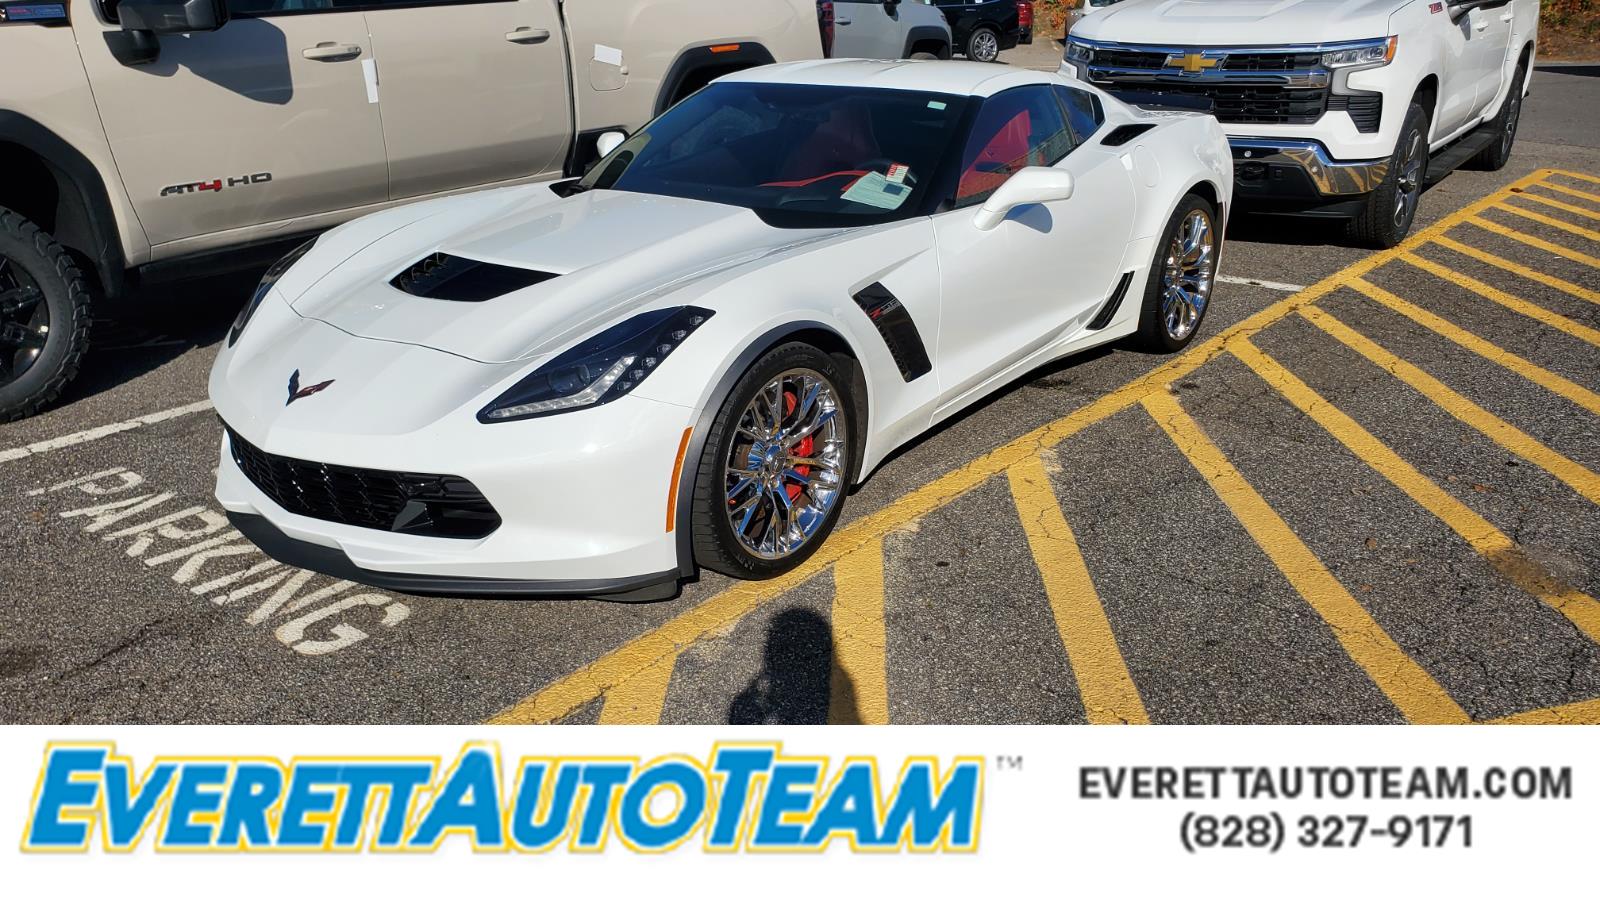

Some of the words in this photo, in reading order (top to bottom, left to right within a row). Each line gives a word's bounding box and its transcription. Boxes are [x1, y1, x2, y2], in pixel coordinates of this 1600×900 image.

[160, 179, 222, 197] AT4
[227, 172, 272, 187] HD
[27, 466, 411, 656] PARKING
